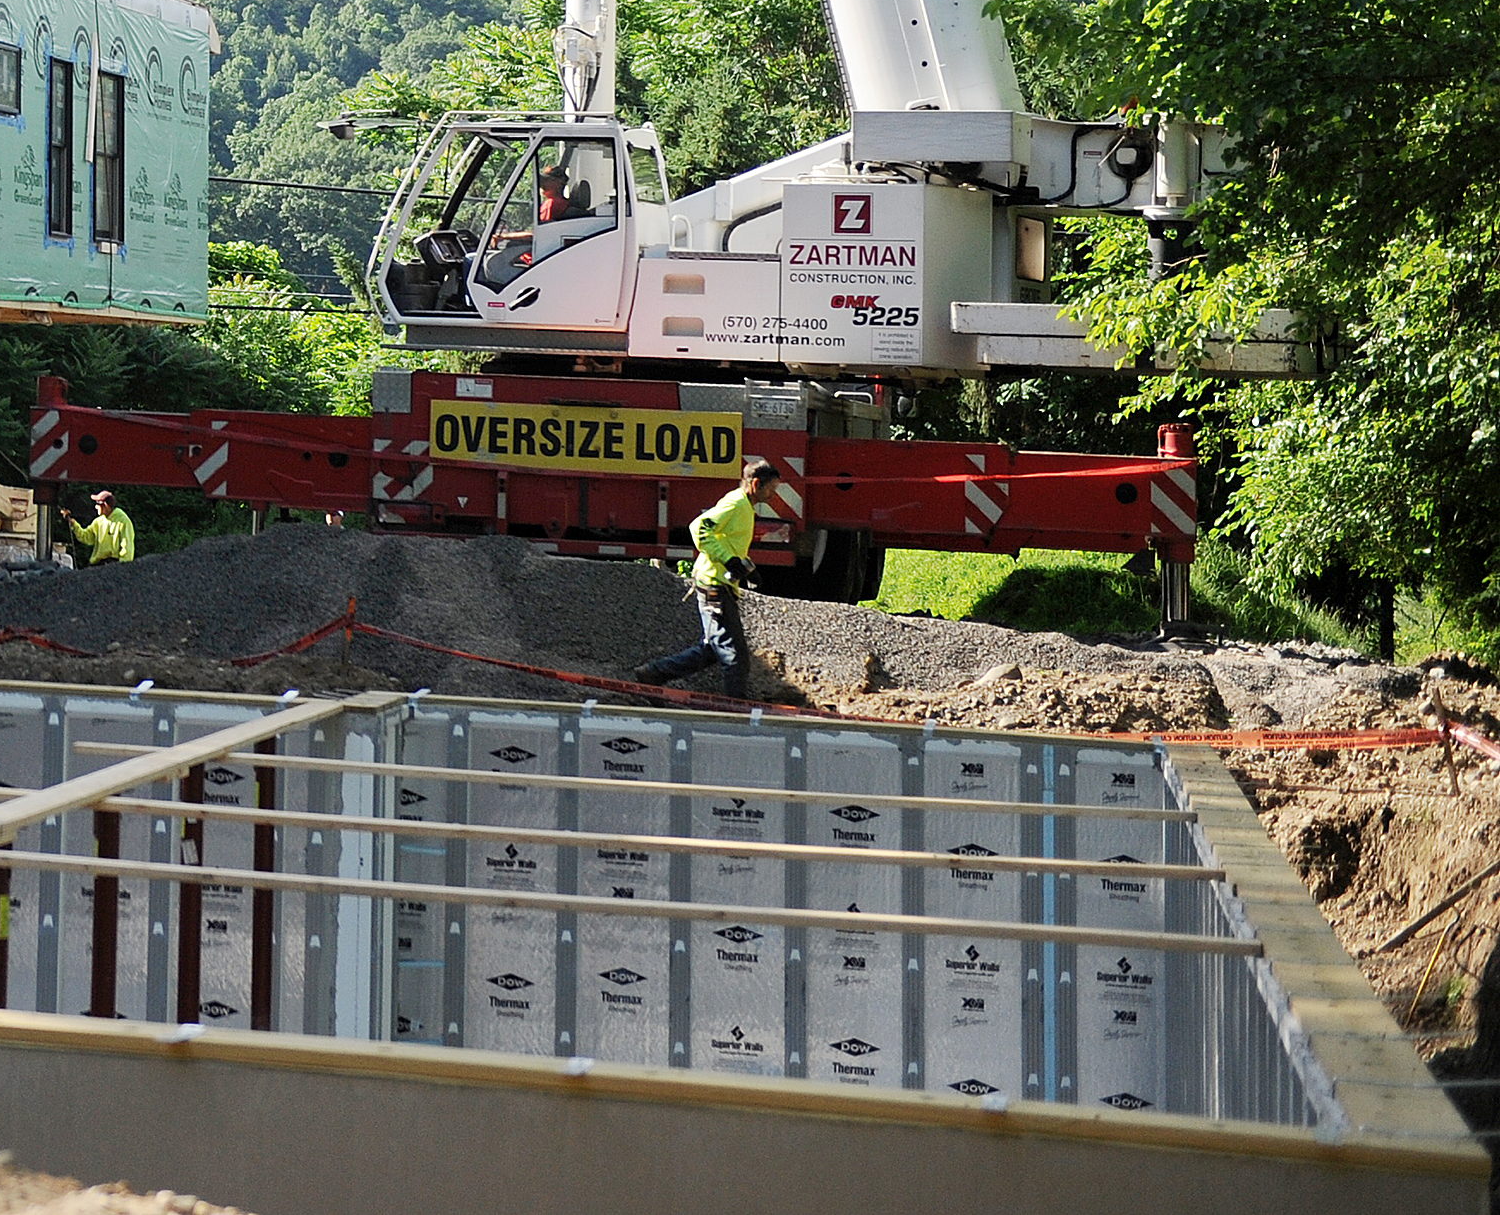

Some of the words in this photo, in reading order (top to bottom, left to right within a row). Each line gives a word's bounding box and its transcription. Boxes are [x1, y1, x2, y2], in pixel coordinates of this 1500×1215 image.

[152, 80, 174, 98] Simplex
[186, 88, 207, 105] Simplex
[153, 96, 172, 112] Homes
[187, 104, 206, 119] Homes
[13, 166, 43, 191] Kingspan
[13, 189, 43, 207] GreenGuard
[839, 199, 867, 230] Z
[789, 244, 916, 266] ZARTMAN
[789, 272, 890, 285] CONSTRUCTION,
[892, 275, 917, 285] INC.
[830, 294, 881, 310] GMK
[721, 315, 758, 331] (570)
[762, 316, 828, 331] 275-4400
[852, 307, 920, 327] 5225
[704, 332, 846, 348] www.zartman.com
[434, 413, 626, 460] OVERSIZE
[634, 422, 737, 465] LOAD
[610, 740, 640, 751] DOW
[499, 748, 529, 760] DOW
[602, 759, 645, 774] Thermax
[207, 770, 237, 783] DOW
[204, 792, 240, 805] hermax
[400, 793, 419, 802] OW
[711, 806, 744, 818] Superior
[745, 807, 765, 819] Walls
[840, 808, 872, 820] DOW
[832, 828, 876, 842] Thermax
[596, 848, 628, 860] Superior
[629, 850, 649, 862] Walls
[485, 857, 517, 869] Superior
[518, 858, 537, 870] Walls
[950, 867, 994, 881] Thermax
[1100, 877, 1147, 893] Thermax
[724, 929, 755, 941] DOW
[716, 948, 759, 963] Thermax
[945, 959, 977, 971] Superior
[979, 960, 1000, 972] Walls
[497, 976, 527, 989] DOW
[609, 971, 638, 983] DOW
[1096, 971, 1129, 983] Superior
[1131, 973, 1153, 985] Walls
[488, 995, 530, 1010] Thermax
[601, 991, 643, 1005] Thermax
[711, 1038, 742, 1051] Superior
[743, 1040, 764, 1052] Walls
[840, 1041, 872, 1054] DOW
[832, 1061, 876, 1076] Thermax
[959, 1082, 990, 1094] DOW
[1111, 1097, 1144, 1110] DOW
